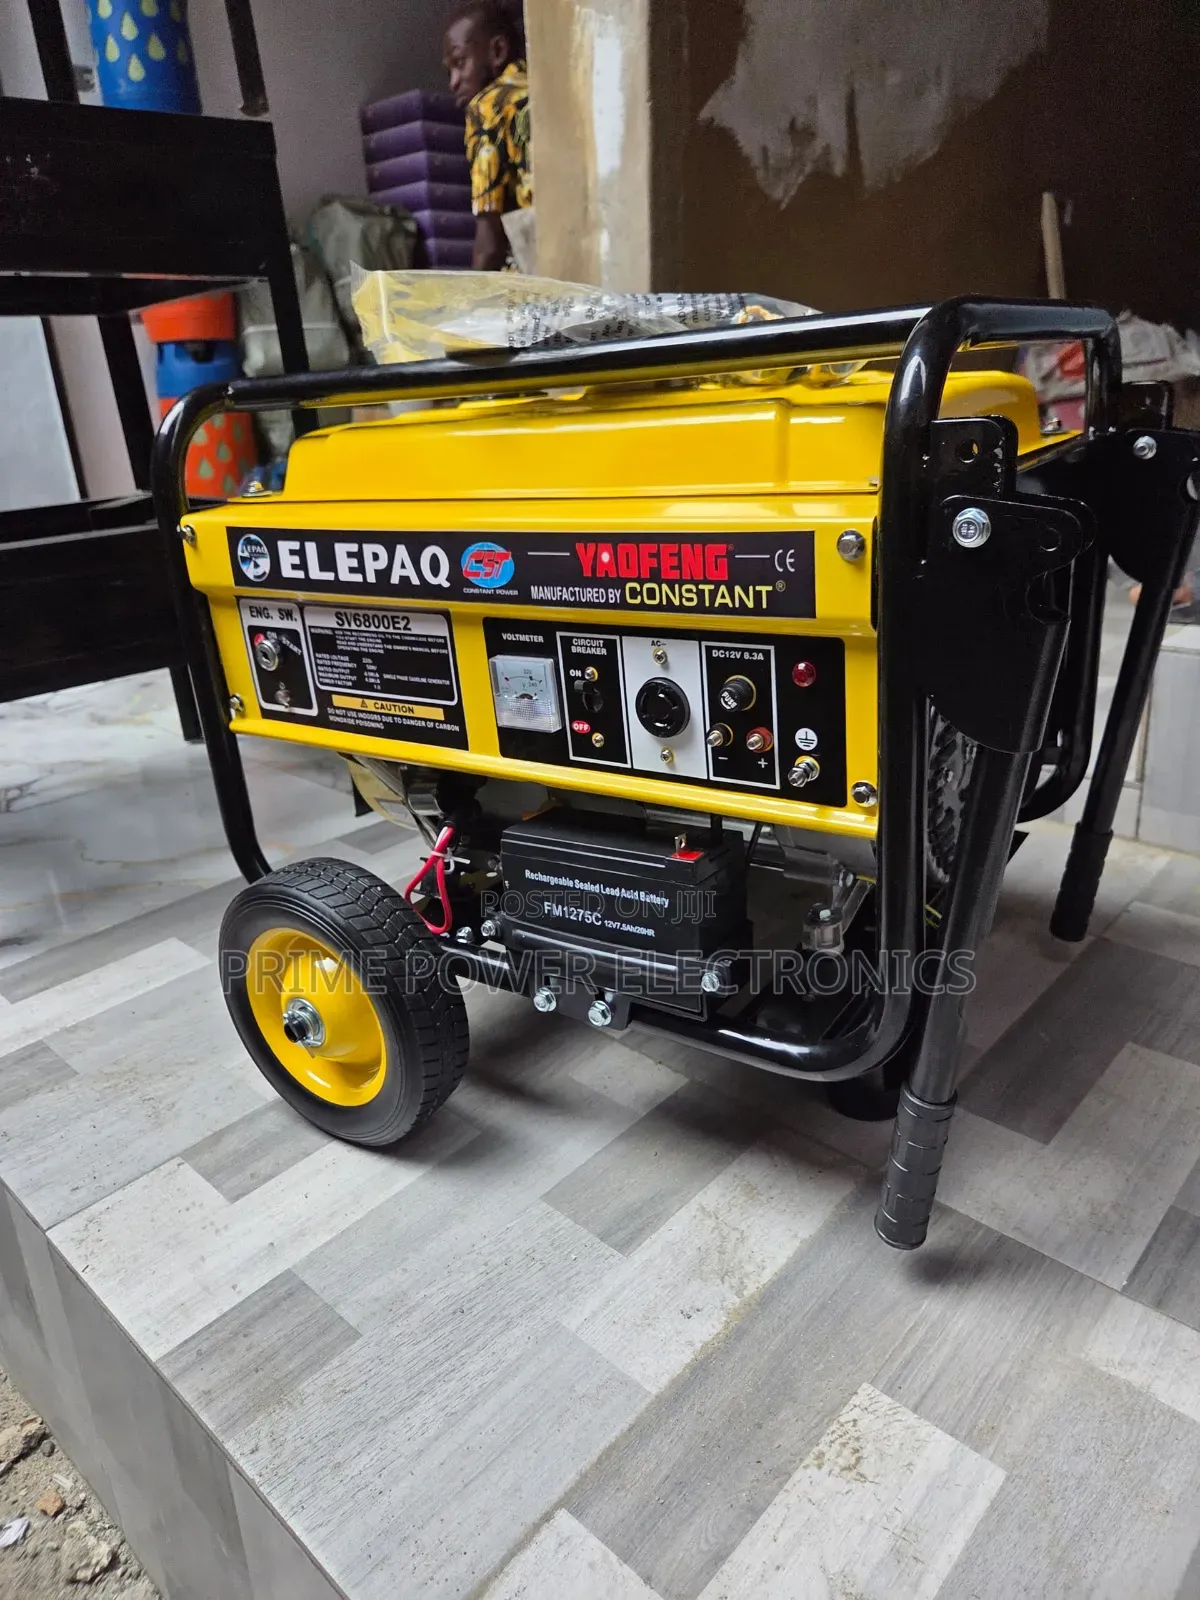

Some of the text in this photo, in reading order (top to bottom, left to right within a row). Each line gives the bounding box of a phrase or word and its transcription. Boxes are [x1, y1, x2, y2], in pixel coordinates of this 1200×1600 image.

[277, 540, 451, 588] ELEPAQ
[463, 550, 512, 579] CST
[575, 543, 729, 580] YAOFENG
[774, 549, 796, 573] CE
[463, 587, 494, 595] CONSTANT
[530, 582, 773, 609] MANUFACTURED BY CONSTANT
[249, 606, 298, 622] ENG. SW.
[335, 611, 412, 631] SV6800E2
[281, 636, 302, 655] START
[501, 632, 544, 643] VOLTMETER
[572, 638, 604, 647] CIRCUIT
[571, 645, 607, 655] BREAKER
[712, 649, 764, 661] DC12V 8.3A
[569, 669, 582, 677] ON
[373, 702, 415, 714] CAUTION
[721, 691, 738, 709] FUSE
[335, 708, 346, 716] NOT
[358, 711, 381, 721] INDOORS
[382, 715, 393, 723] DUE
[403, 718, 426, 728] DANGER
[435, 722, 460, 732] CARBON
[356, 719, 384, 729] POISONING
[573, 721, 589, 731] OFF
[525, 869, 669, 908] Rechargeable Sealed Lead Acid Battery
[544, 901, 602, 926] FM1275C
